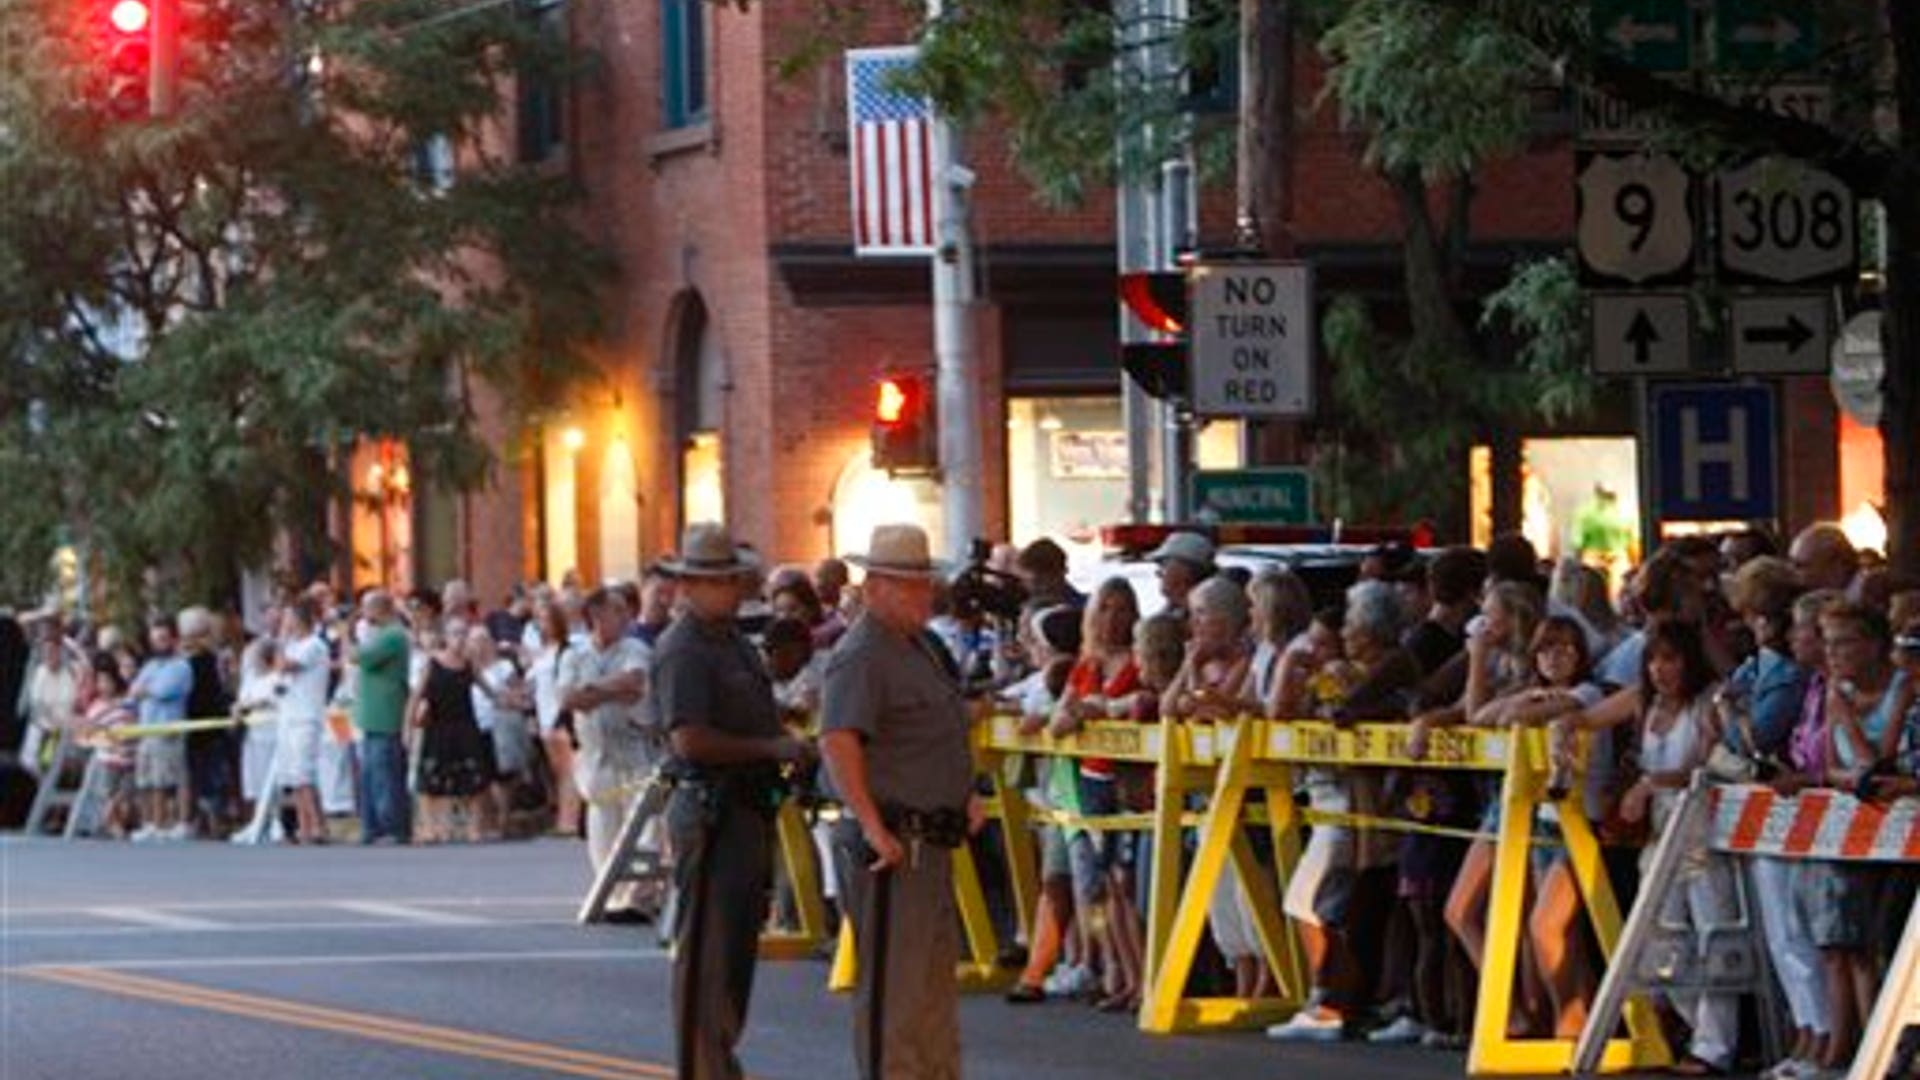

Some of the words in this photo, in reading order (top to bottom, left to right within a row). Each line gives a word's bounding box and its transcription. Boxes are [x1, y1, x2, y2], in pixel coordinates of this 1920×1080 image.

[1615, 183, 1654, 252] 9
[1732, 190, 1843, 250] 308
[1224, 276, 1276, 305] NO
[1216, 314, 1287, 338] TURN
[1233, 346, 1270, 371] ON
[1224, 379, 1276, 404] RED
[1681, 405, 1747, 500] H
